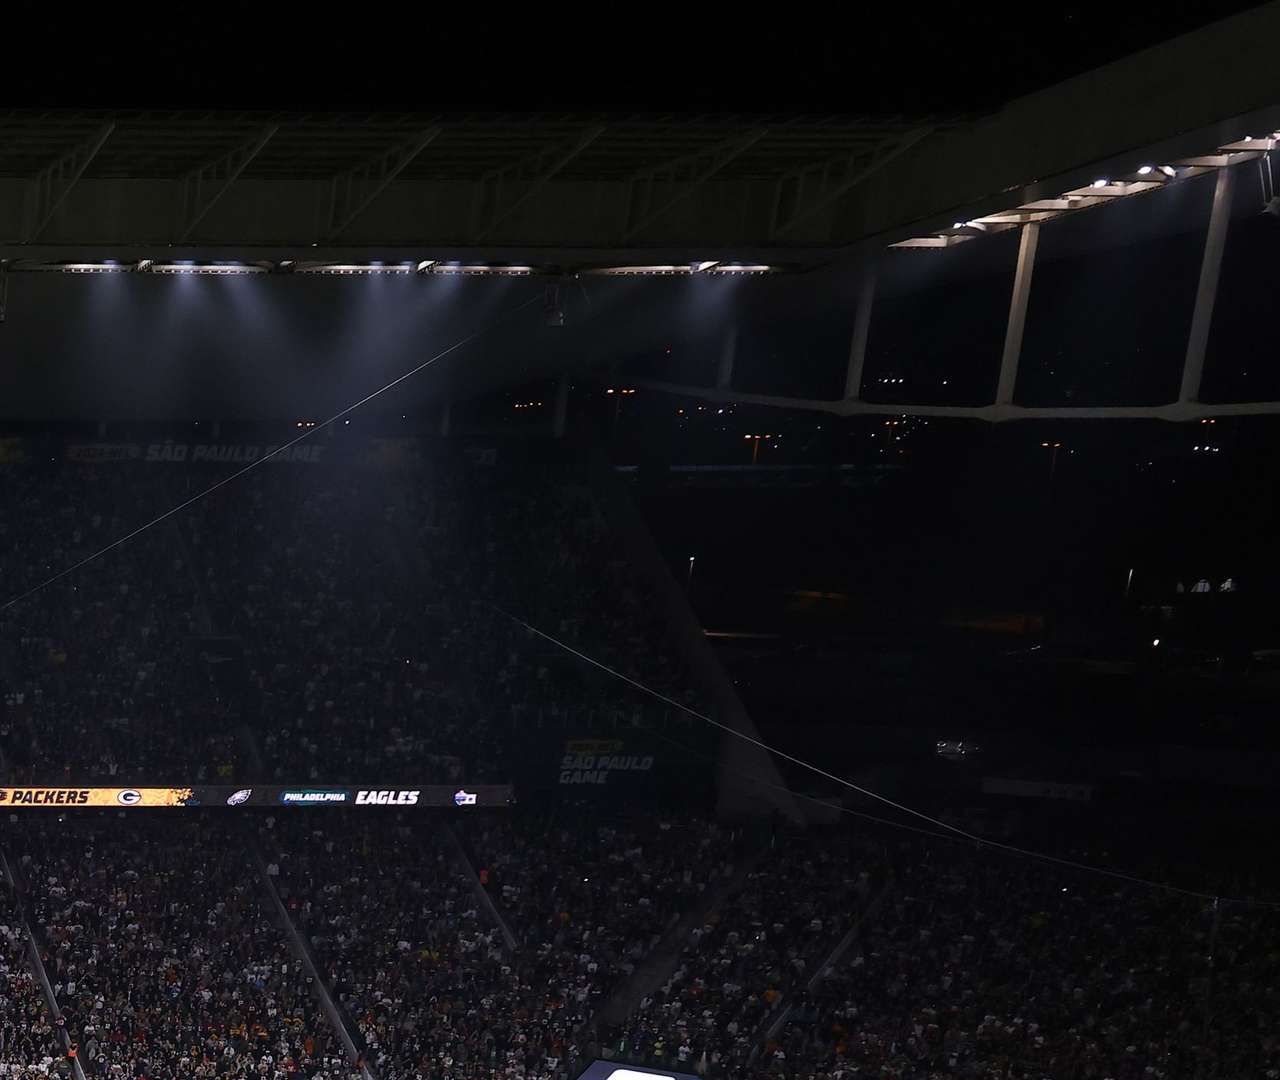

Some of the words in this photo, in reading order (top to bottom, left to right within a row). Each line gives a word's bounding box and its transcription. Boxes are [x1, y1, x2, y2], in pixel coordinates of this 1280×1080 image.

[11, 791, 90, 804] PACKERS
[283, 793, 345, 802] PHILADELPHIA
[355, 791, 420, 805] EAGLES
